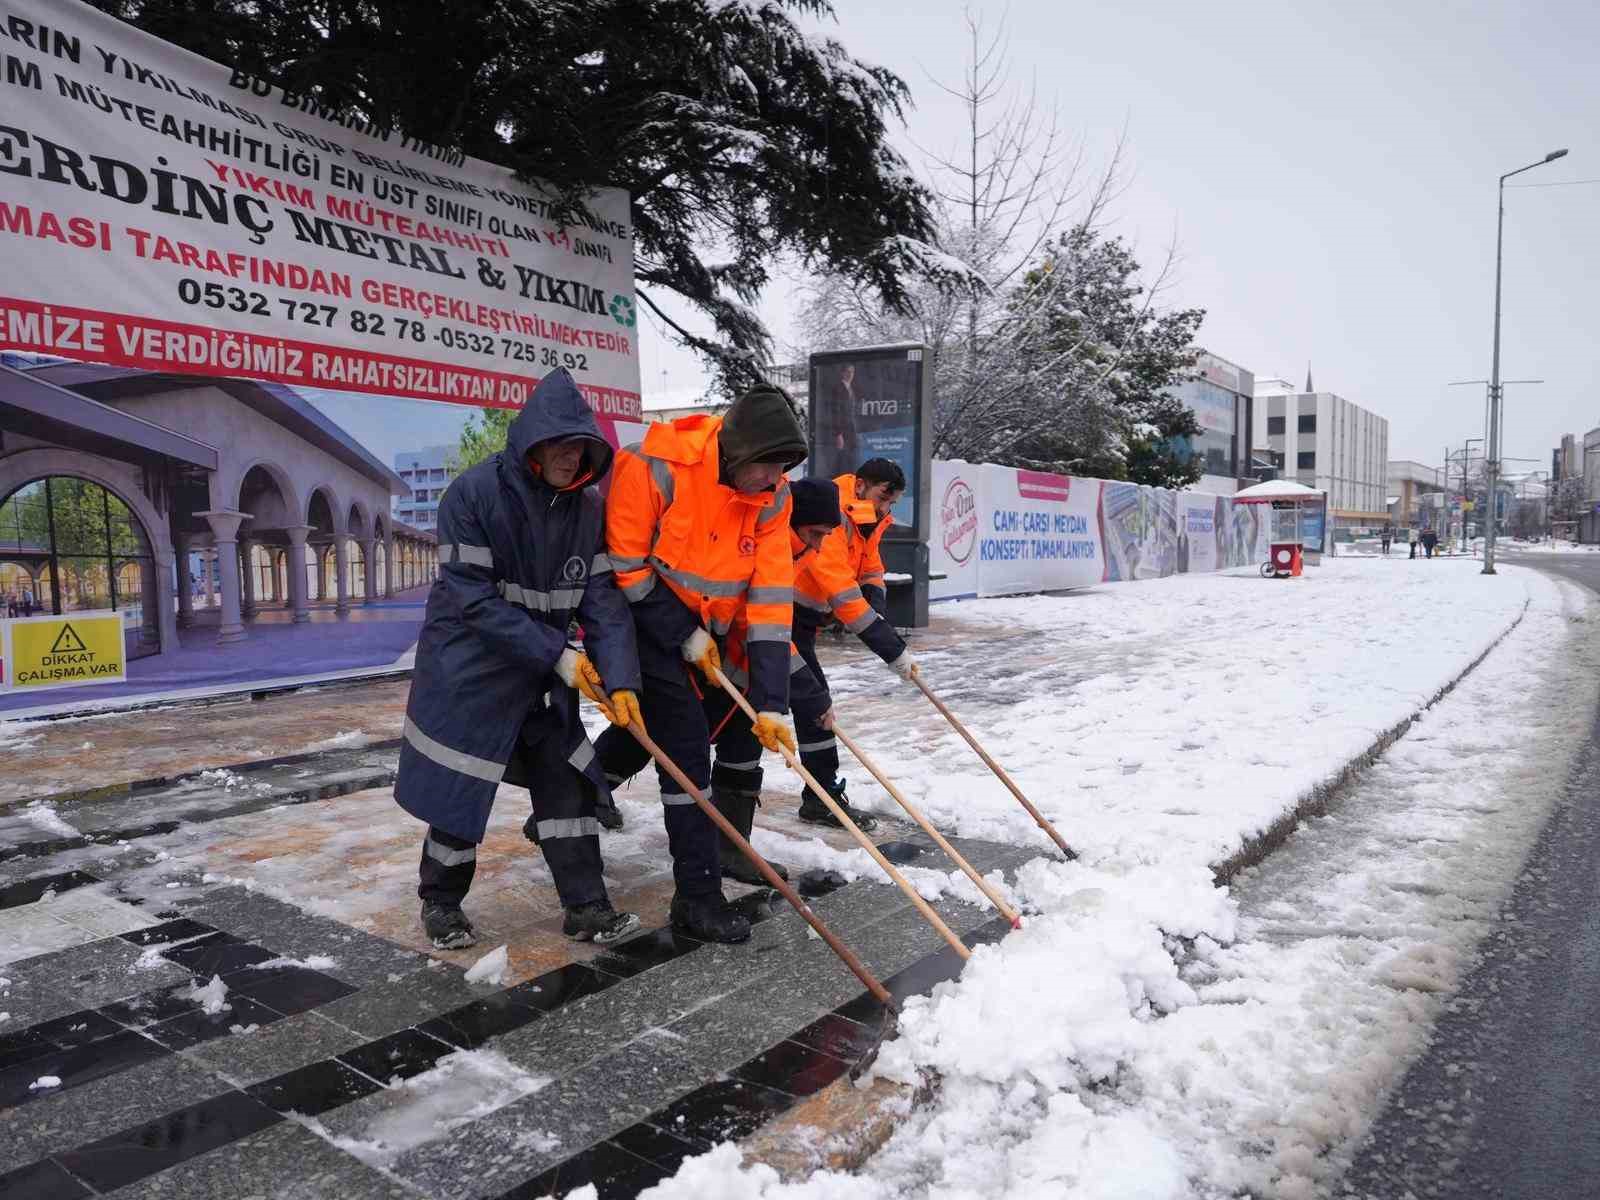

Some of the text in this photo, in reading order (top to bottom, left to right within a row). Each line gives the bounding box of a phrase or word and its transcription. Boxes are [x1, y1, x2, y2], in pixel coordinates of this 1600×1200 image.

[0, 14, 81, 64] RIN
[94, 44, 268, 129] YIKILMASI
[272, 121, 345, 156] GRUP
[352, 149, 483, 198] BELİRLEME
[0, 54, 43, 91] M
[54, 72, 321, 181] MÜTEAHHİTLİĞİ
[330, 163, 364, 195] EN
[373, 175, 419, 209] ÜST
[424, 194, 483, 230] SINIFI
[488, 215, 542, 243] OLAN
[205, 158, 511, 258] YIKIM MÜTEAHHİTİ
[126, 227, 353, 299] TARAFINDAN
[361, 279, 632, 356] GERÇEKLEŞTİRİLMEKTEDİR
[285, 207, 466, 280] METAL
[477, 257, 506, 290] &
[514, 264, 610, 316] YIKIM
[116, 324, 304, 378] VERDİĞİMİZ
[312, 351, 496, 402] RAHATSIZLIKTAN
[178, 278, 271, 317] 0532
[278, 298, 338, 328] 727
[350, 310, 386, 337] 82
[393, 317, 427, 343] 78
[501, 339, 536, 363] 725
[541, 347, 559, 368] 36
[563, 353, 589, 371] 92
[18, 663, 118, 684] ÇALIŞMA VAR
[41, 652, 96, 666] DİKKAT
